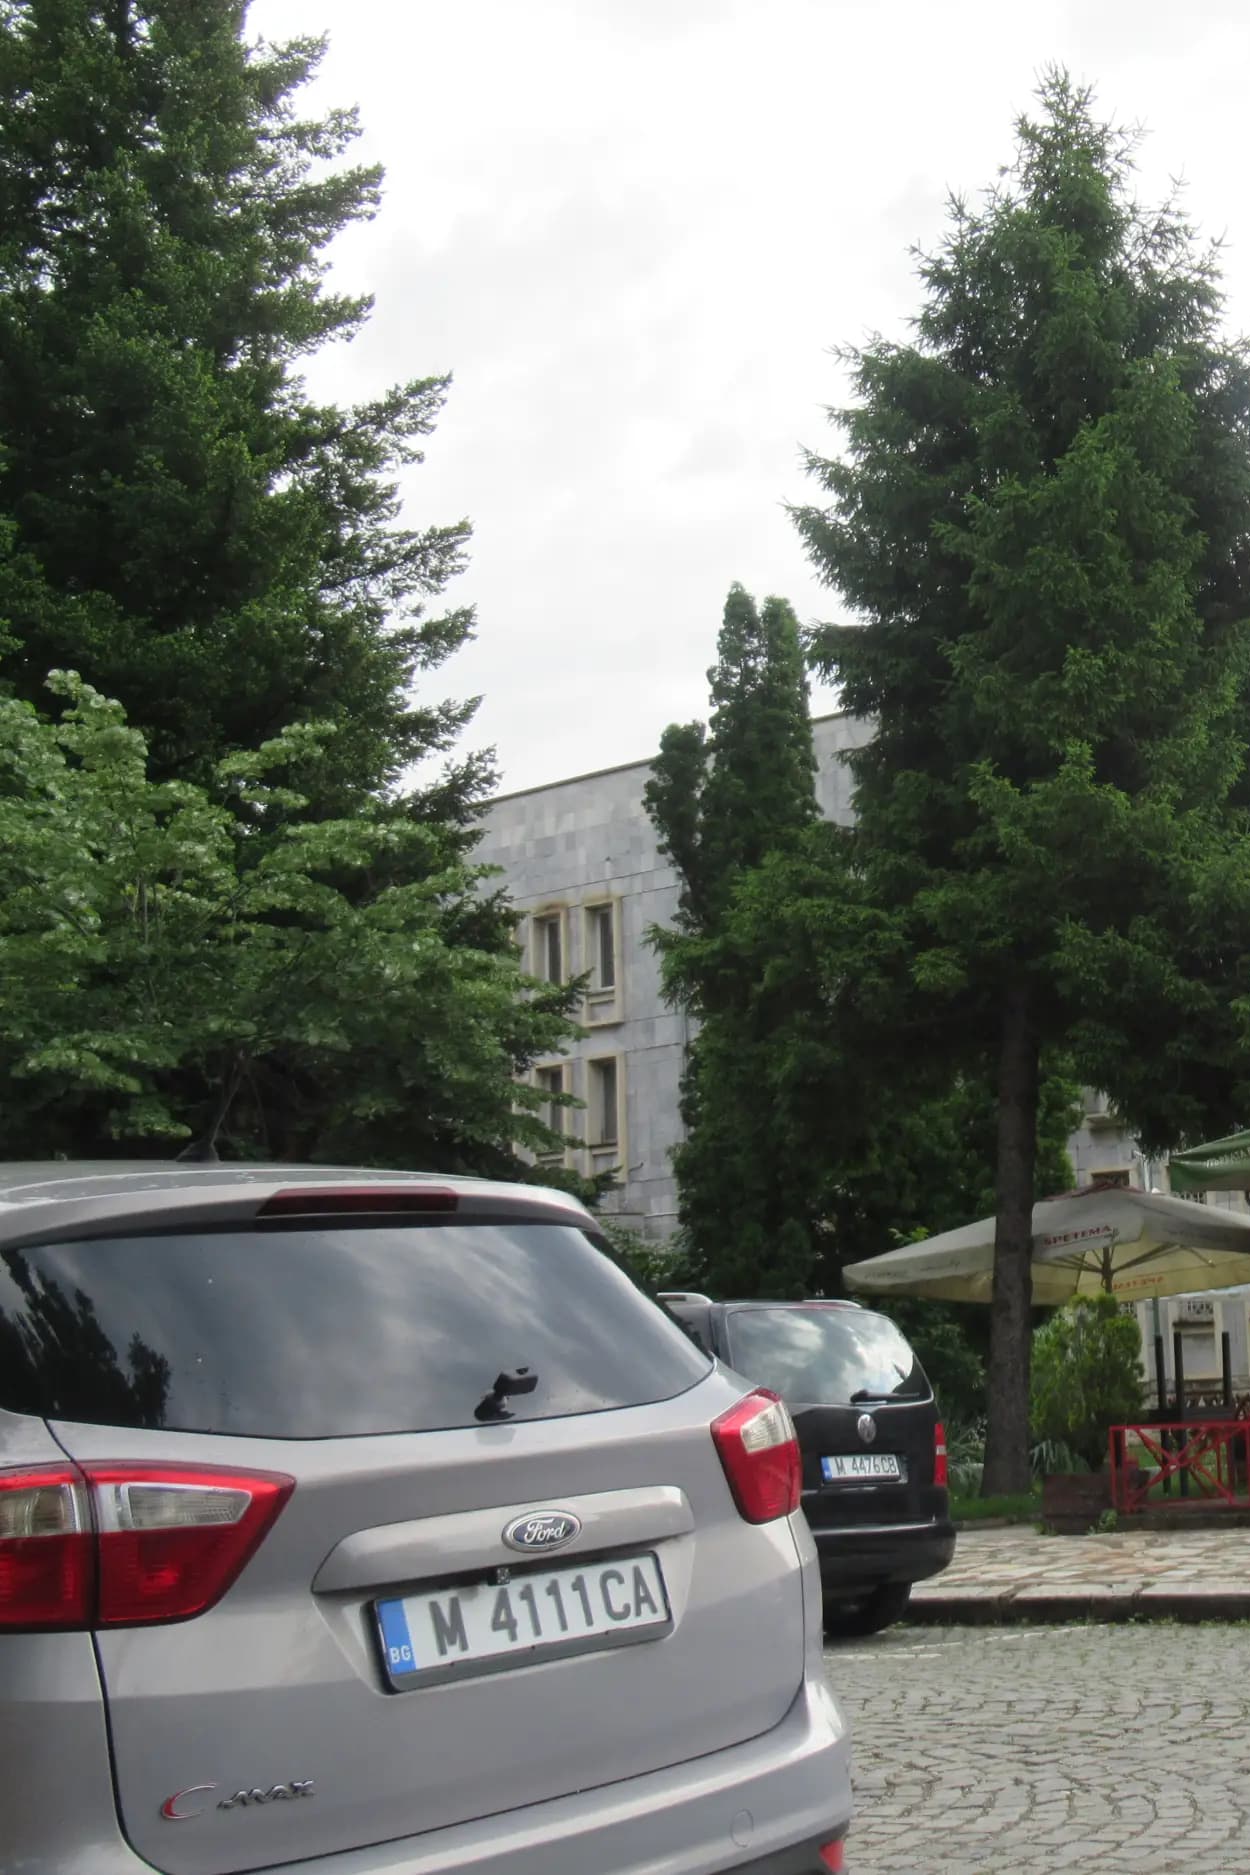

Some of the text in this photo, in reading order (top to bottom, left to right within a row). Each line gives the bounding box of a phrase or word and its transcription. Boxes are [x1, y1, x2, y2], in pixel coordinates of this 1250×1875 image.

[834, 1456, 846, 1475] M
[523, 1518, 567, 1544] Ford
[429, 1565, 658, 1656] M 4111CA
[390, 1644, 413, 1664] BG
